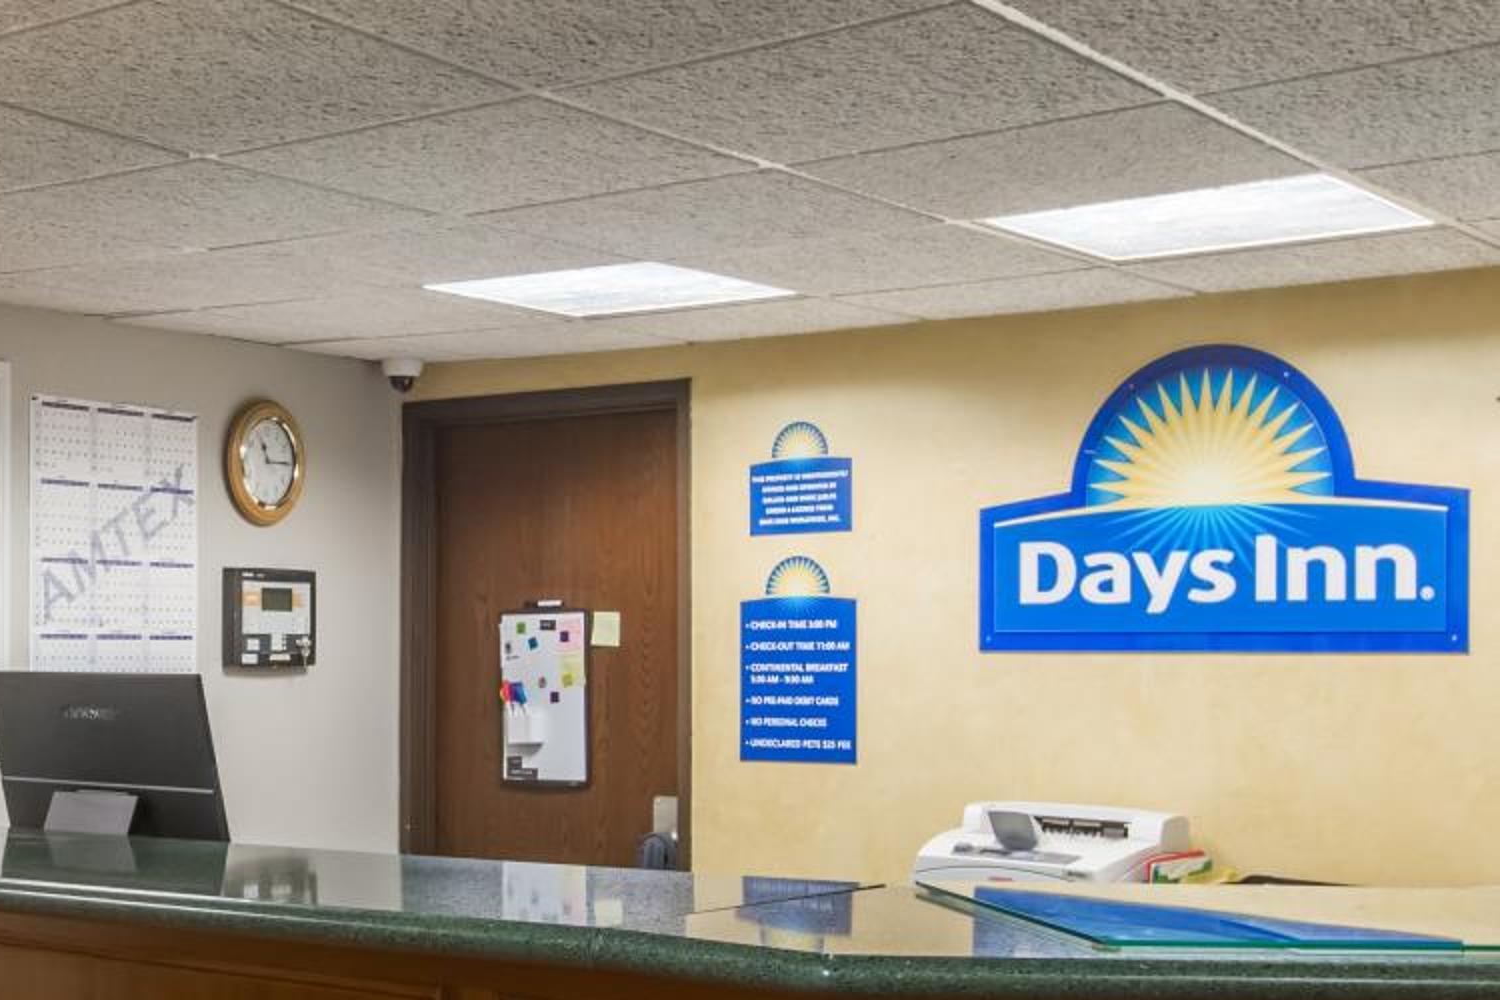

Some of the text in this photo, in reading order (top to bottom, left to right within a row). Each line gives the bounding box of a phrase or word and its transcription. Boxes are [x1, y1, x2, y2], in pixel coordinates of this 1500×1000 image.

[43, 462, 196, 626] AMTEX
[1018, 541, 1237, 614] Days
[825, 619, 837, 629] PM
[837, 641, 851, 651] AM
[750, 696, 762, 705] NO
[750, 717, 762, 727] NO
